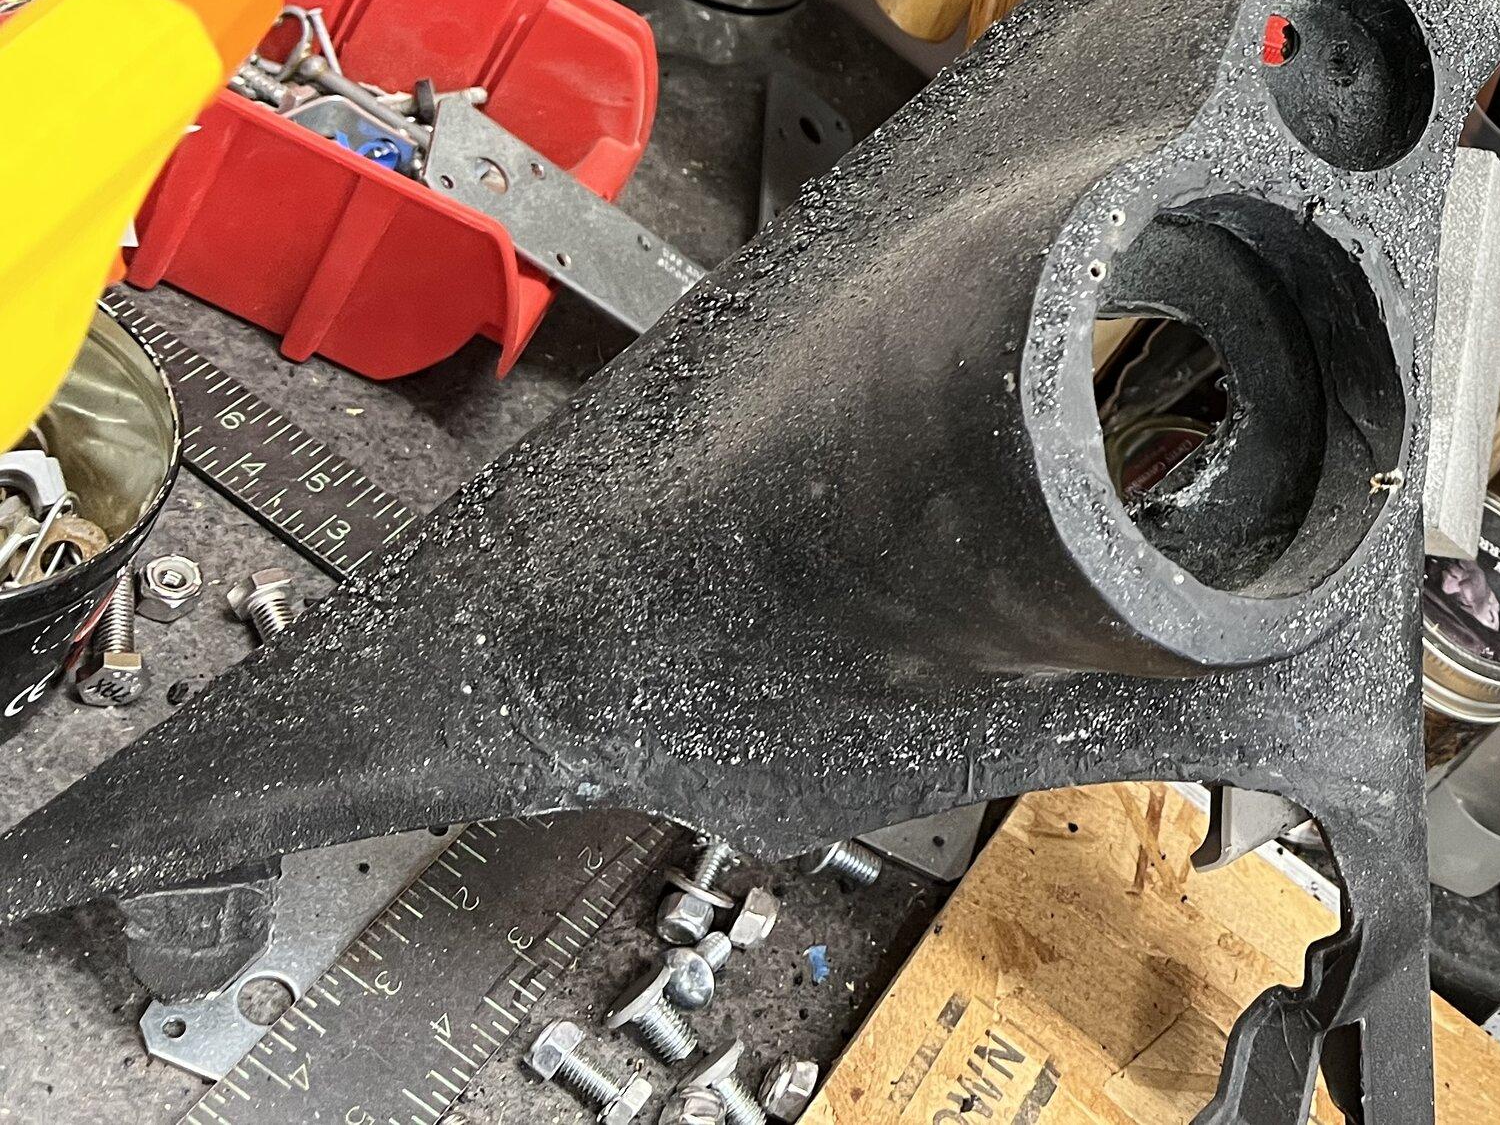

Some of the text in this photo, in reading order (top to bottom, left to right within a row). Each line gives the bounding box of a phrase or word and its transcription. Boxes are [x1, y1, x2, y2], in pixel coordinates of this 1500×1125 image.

[220, 411, 331, 493] 6 5
[240, 462, 351, 541] 4 3
[577, 844, 604, 871] 2
[452, 885, 481, 911] 2
[507, 925, 535, 951] 3
[374, 971, 403, 997] 3
[430, 1011, 453, 1039] 4
[288, 1055, 313, 1091] 4
